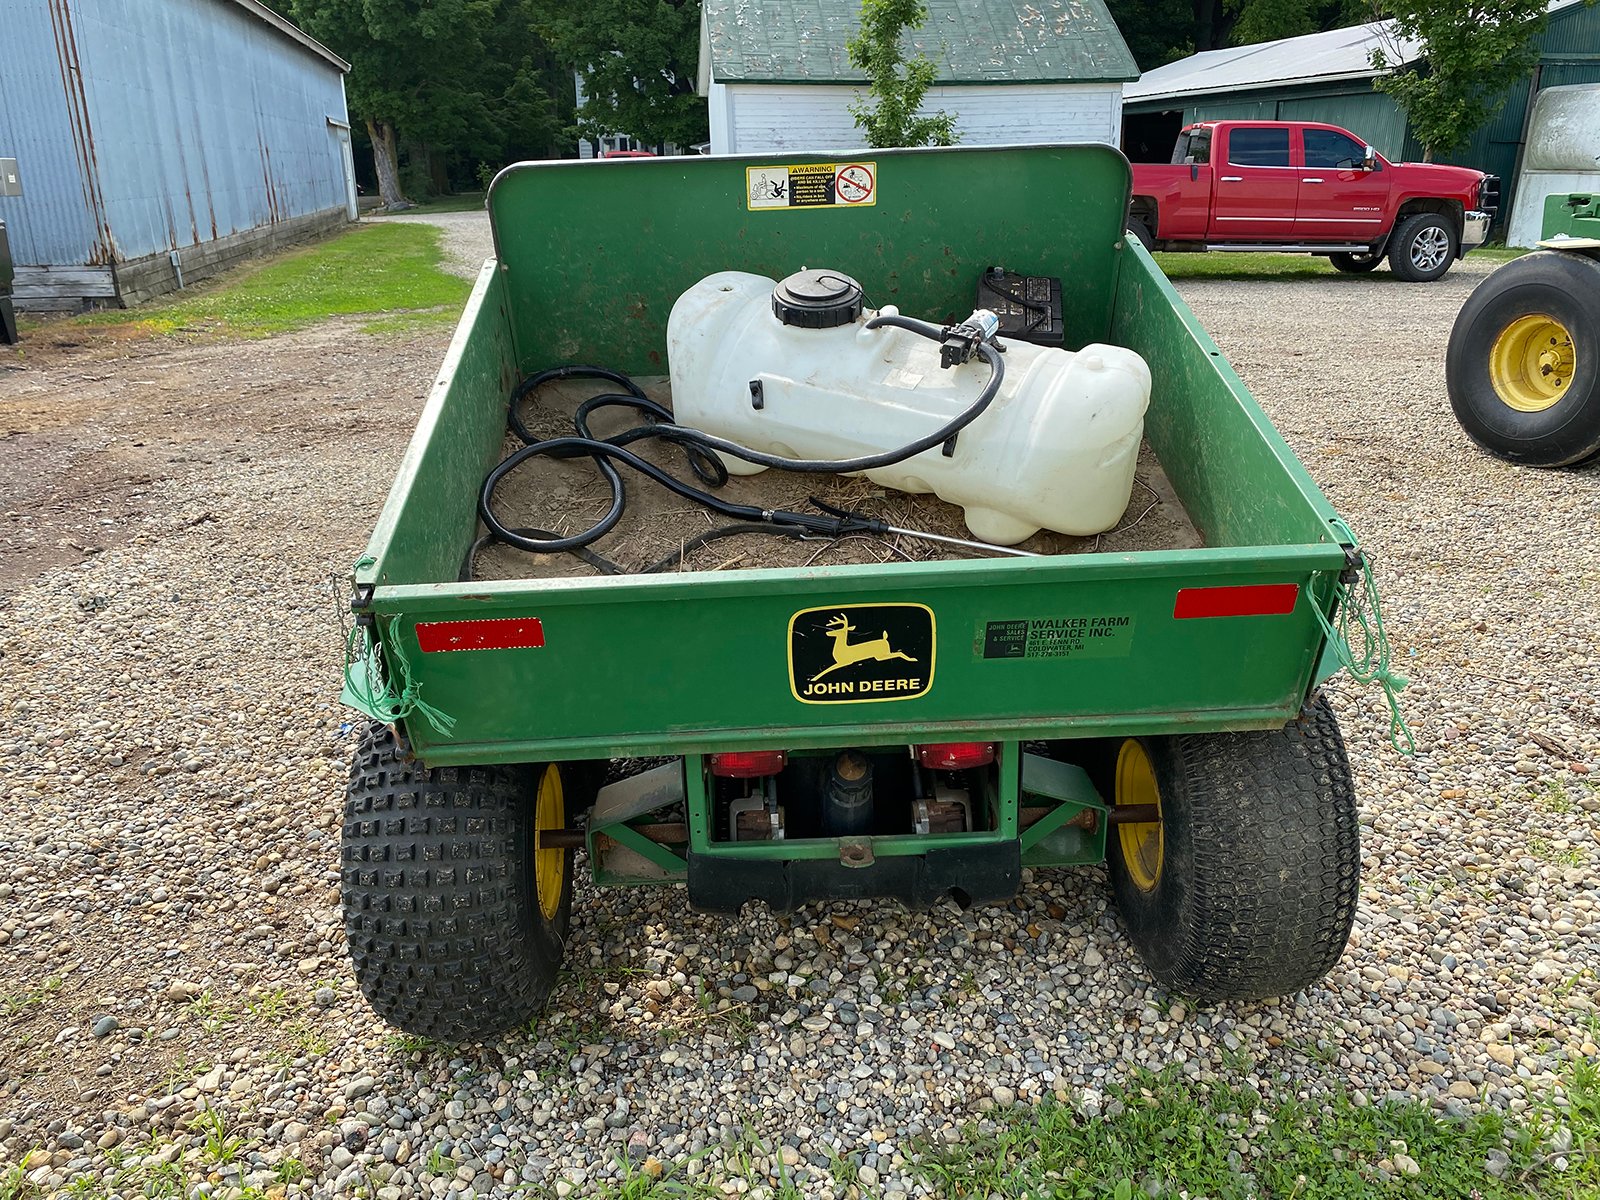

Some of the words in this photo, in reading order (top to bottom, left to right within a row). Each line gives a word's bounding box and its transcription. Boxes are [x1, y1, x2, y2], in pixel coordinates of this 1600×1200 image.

[1031, 619, 1087, 630] WALKER
[1091, 616, 1130, 627] FARM
[1000, 634, 1024, 642] SERVICE
[1030, 628, 1085, 640] SERVICE
[1088, 627, 1115, 638] INC.
[803, 681, 854, 696] JOHN
[859, 678, 921, 693] DEERE
